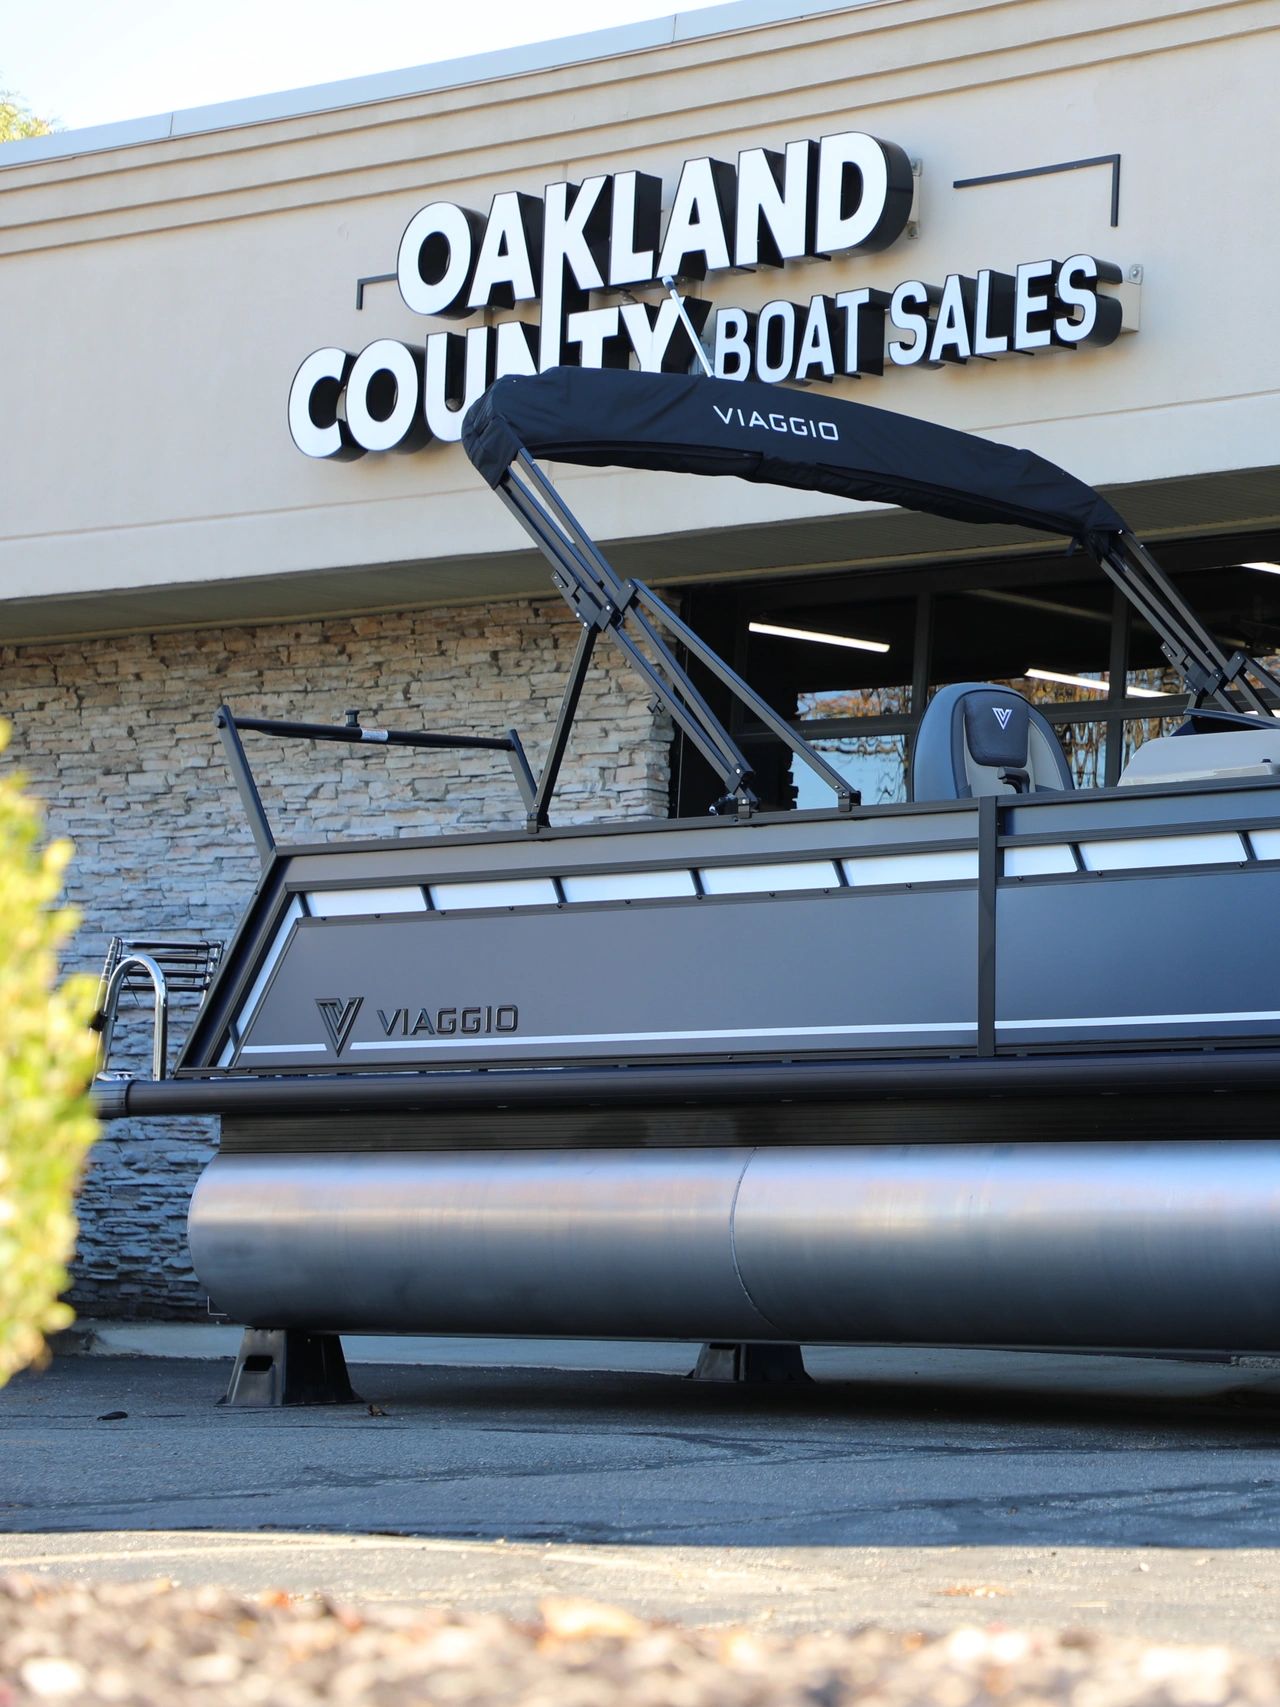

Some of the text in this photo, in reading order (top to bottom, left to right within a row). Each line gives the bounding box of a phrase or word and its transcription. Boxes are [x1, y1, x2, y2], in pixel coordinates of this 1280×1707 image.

[397, 131, 889, 318] OAKLAND
[714, 287, 870, 384] BOAT
[887, 253, 1099, 367] SALES
[712, 405, 839, 441] VIAGGIO
[376, 1004, 519, 1036] VIAGGIO
